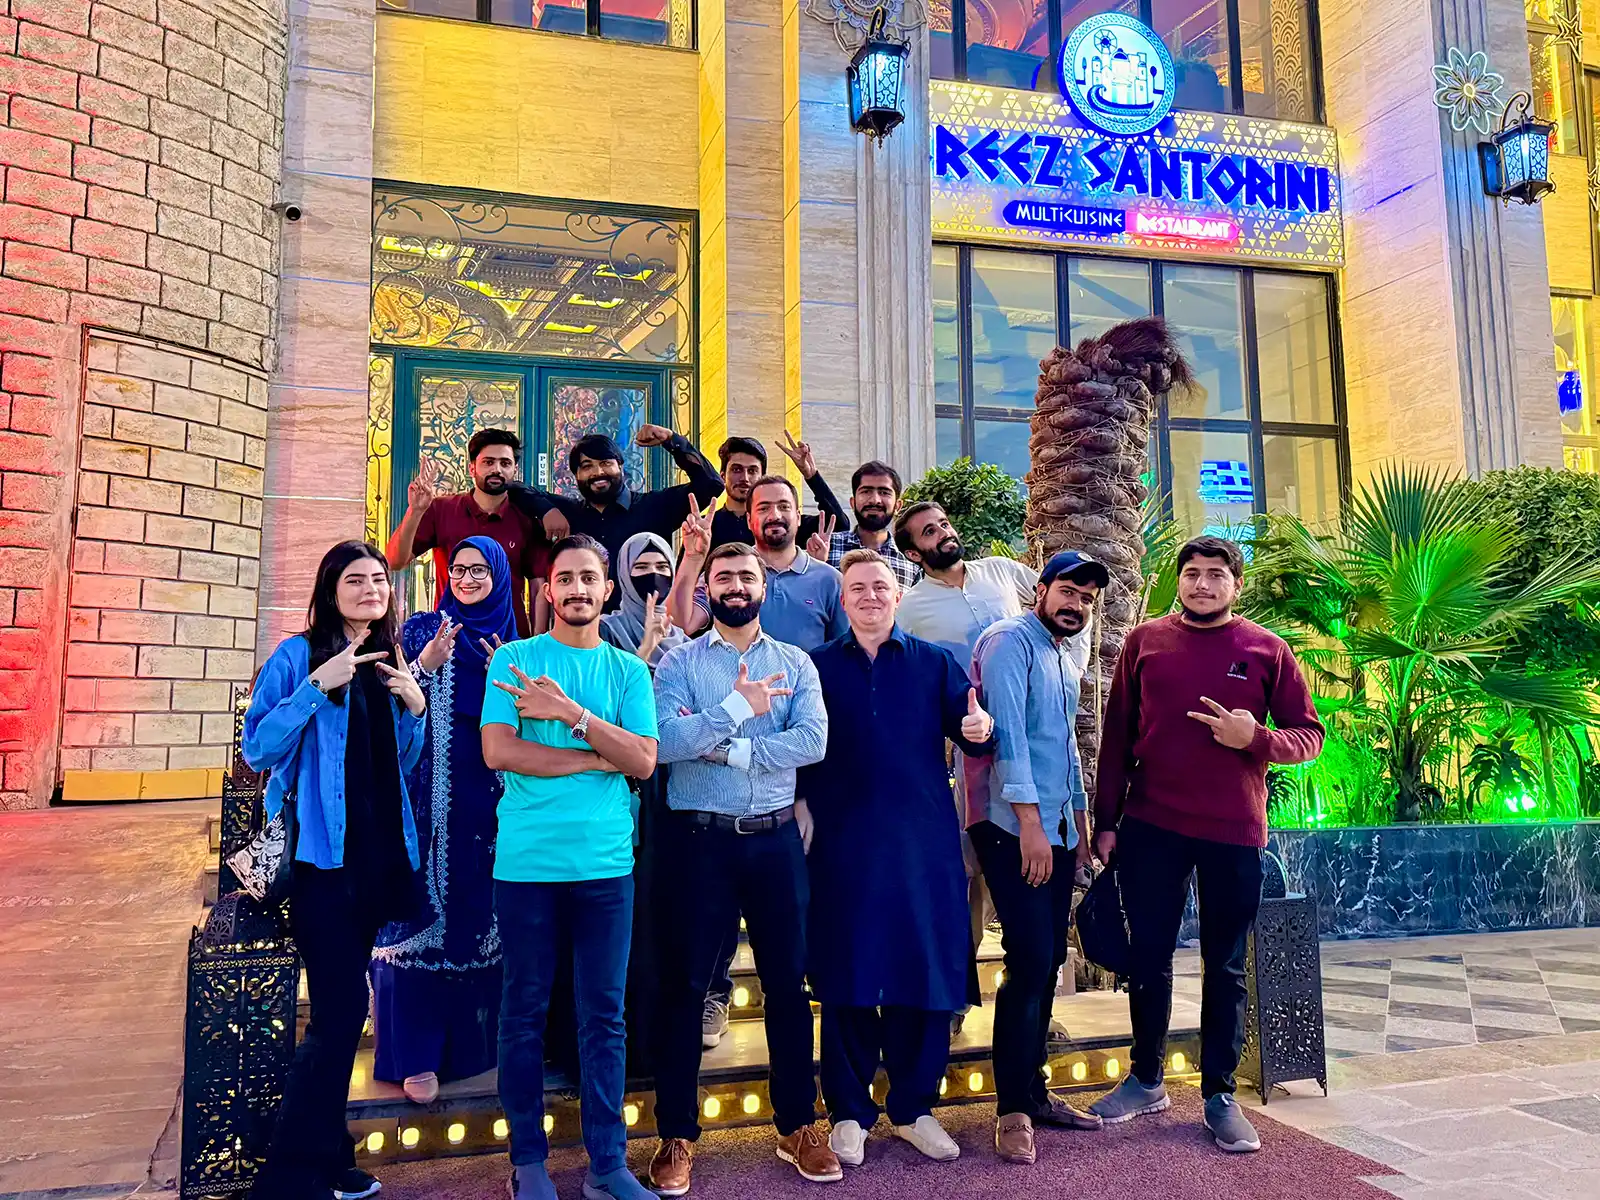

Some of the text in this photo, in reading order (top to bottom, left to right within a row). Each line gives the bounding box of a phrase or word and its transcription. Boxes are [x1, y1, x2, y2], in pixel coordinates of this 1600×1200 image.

[931, 124, 1331, 214] REEZ SANTORINI
[1137, 212, 1231, 239] RESTAURANT
